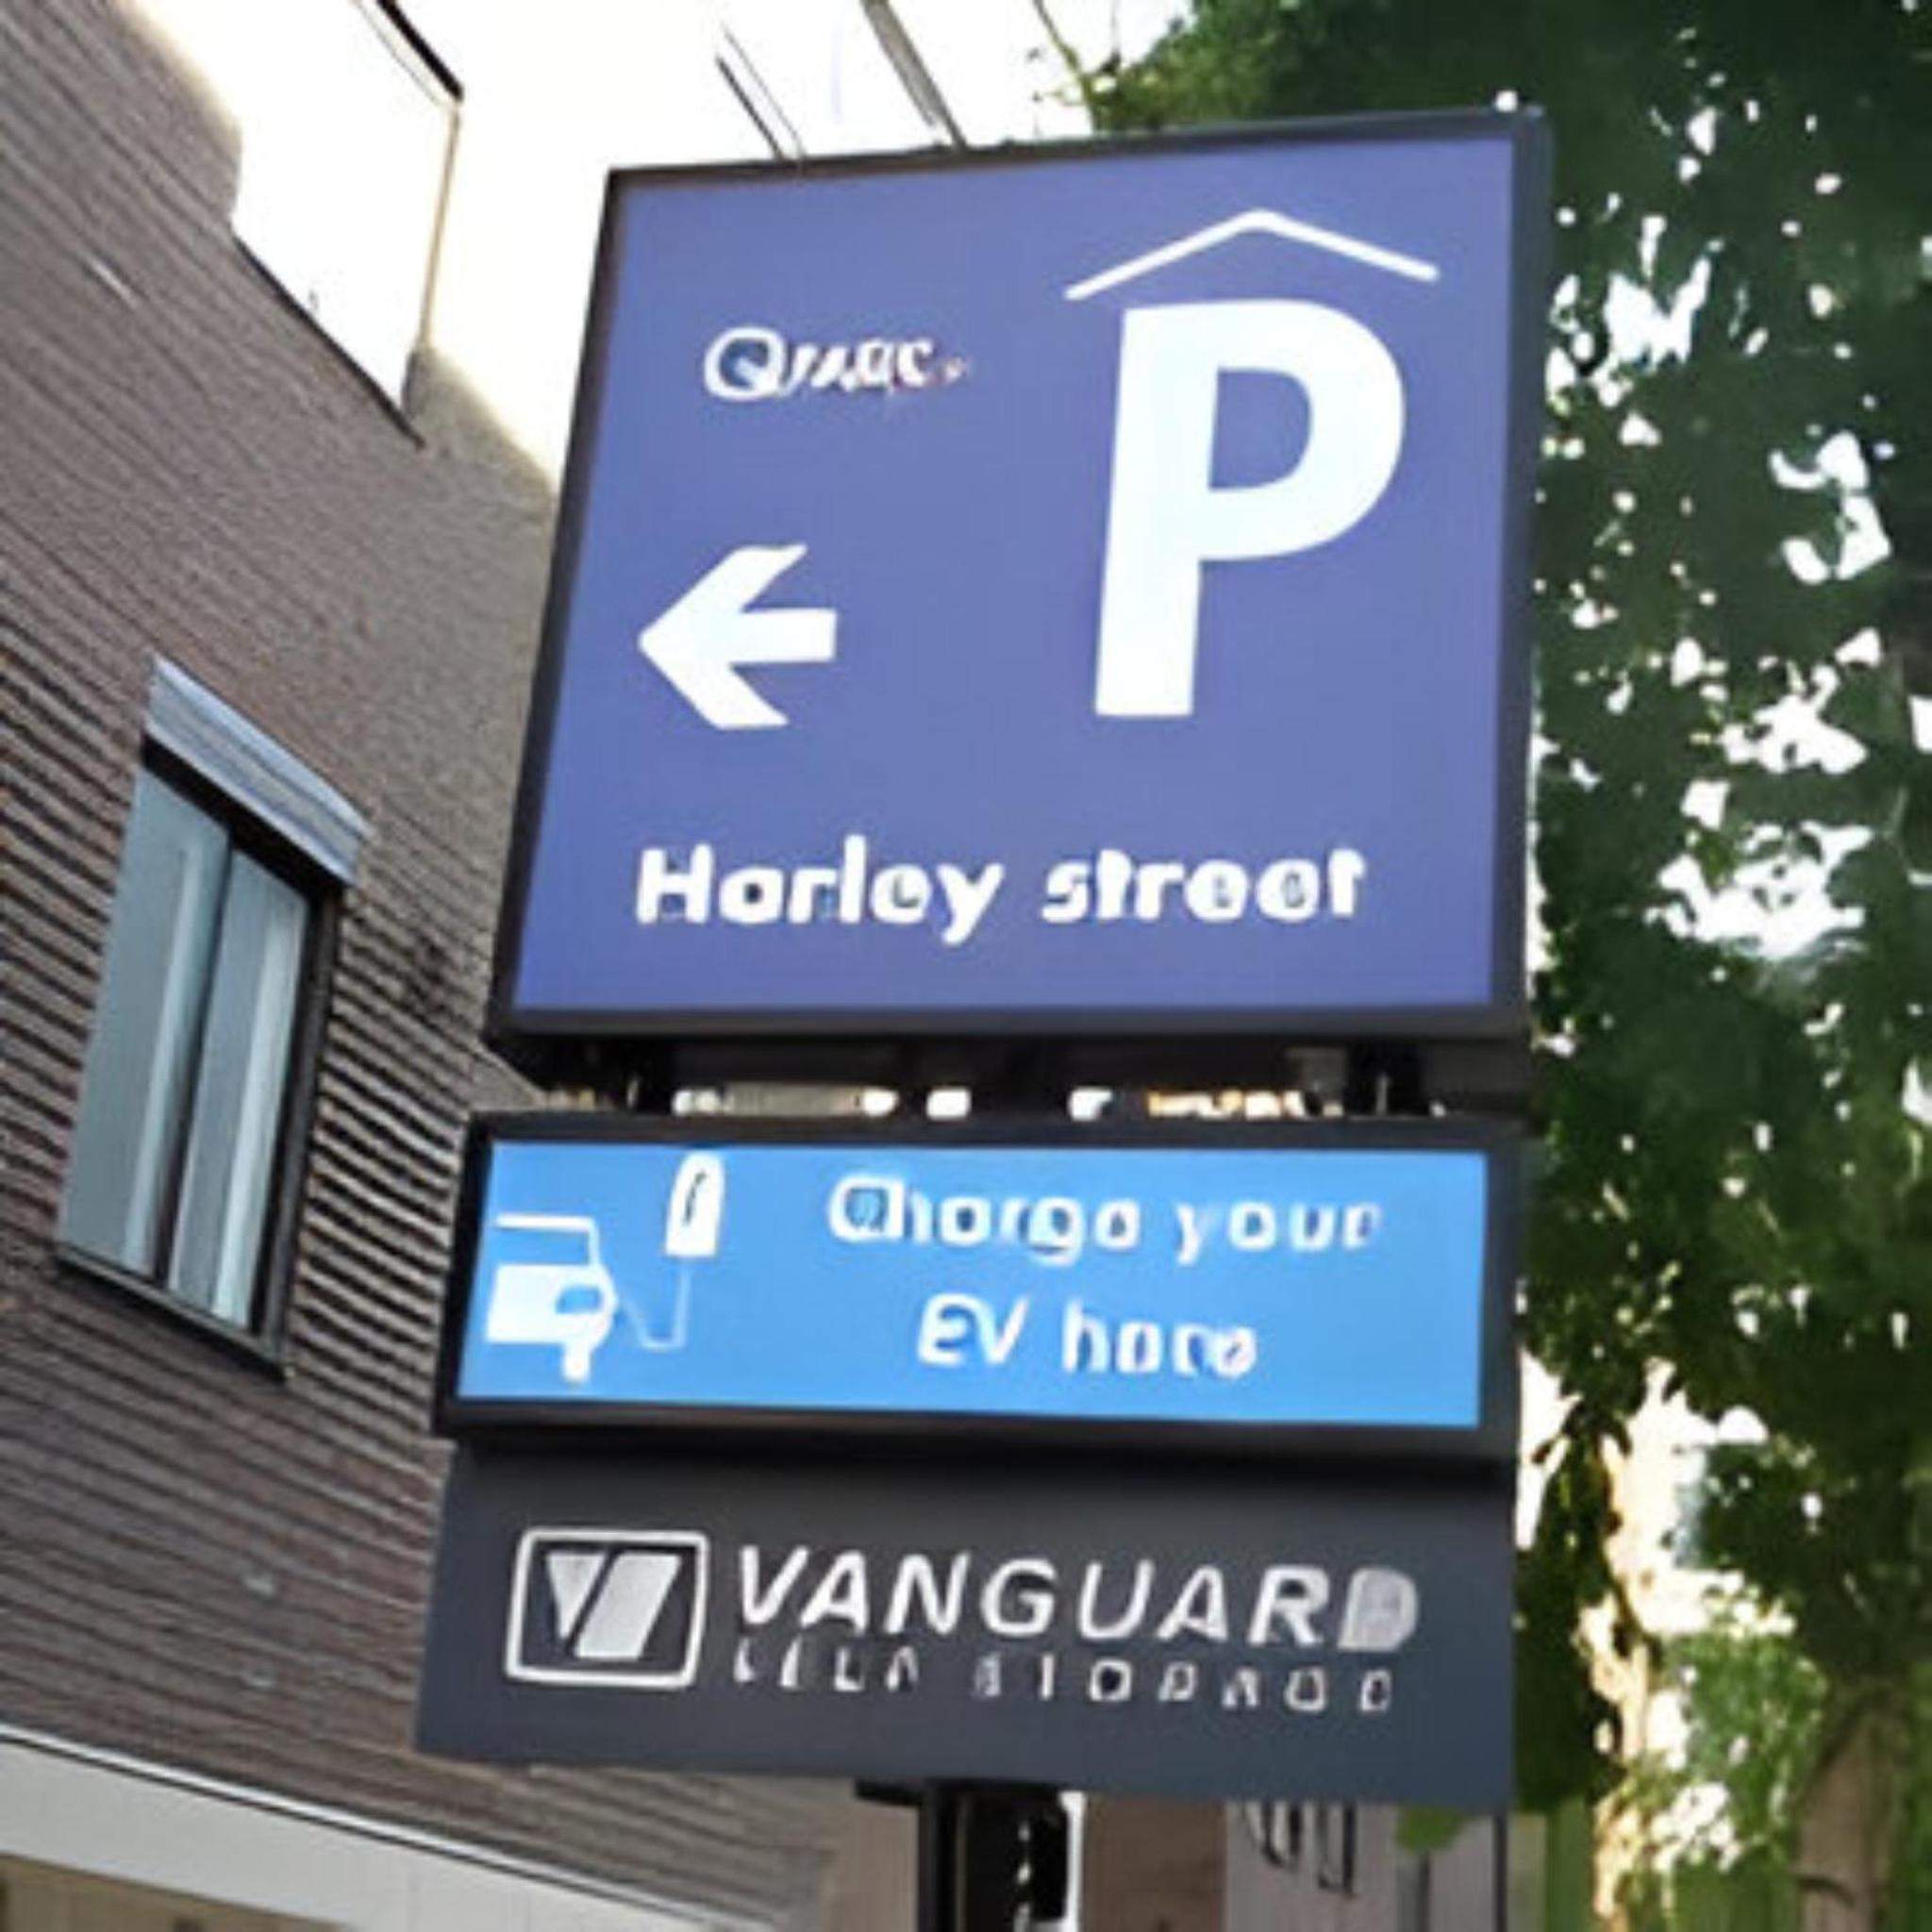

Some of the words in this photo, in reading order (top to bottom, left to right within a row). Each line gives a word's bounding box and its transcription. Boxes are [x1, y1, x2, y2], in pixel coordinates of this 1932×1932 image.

[1094, 298, 1407, 717] P
[917, 1292, 1029, 1364] EV
[739, 1544, 1419, 1653] VANGUARD
